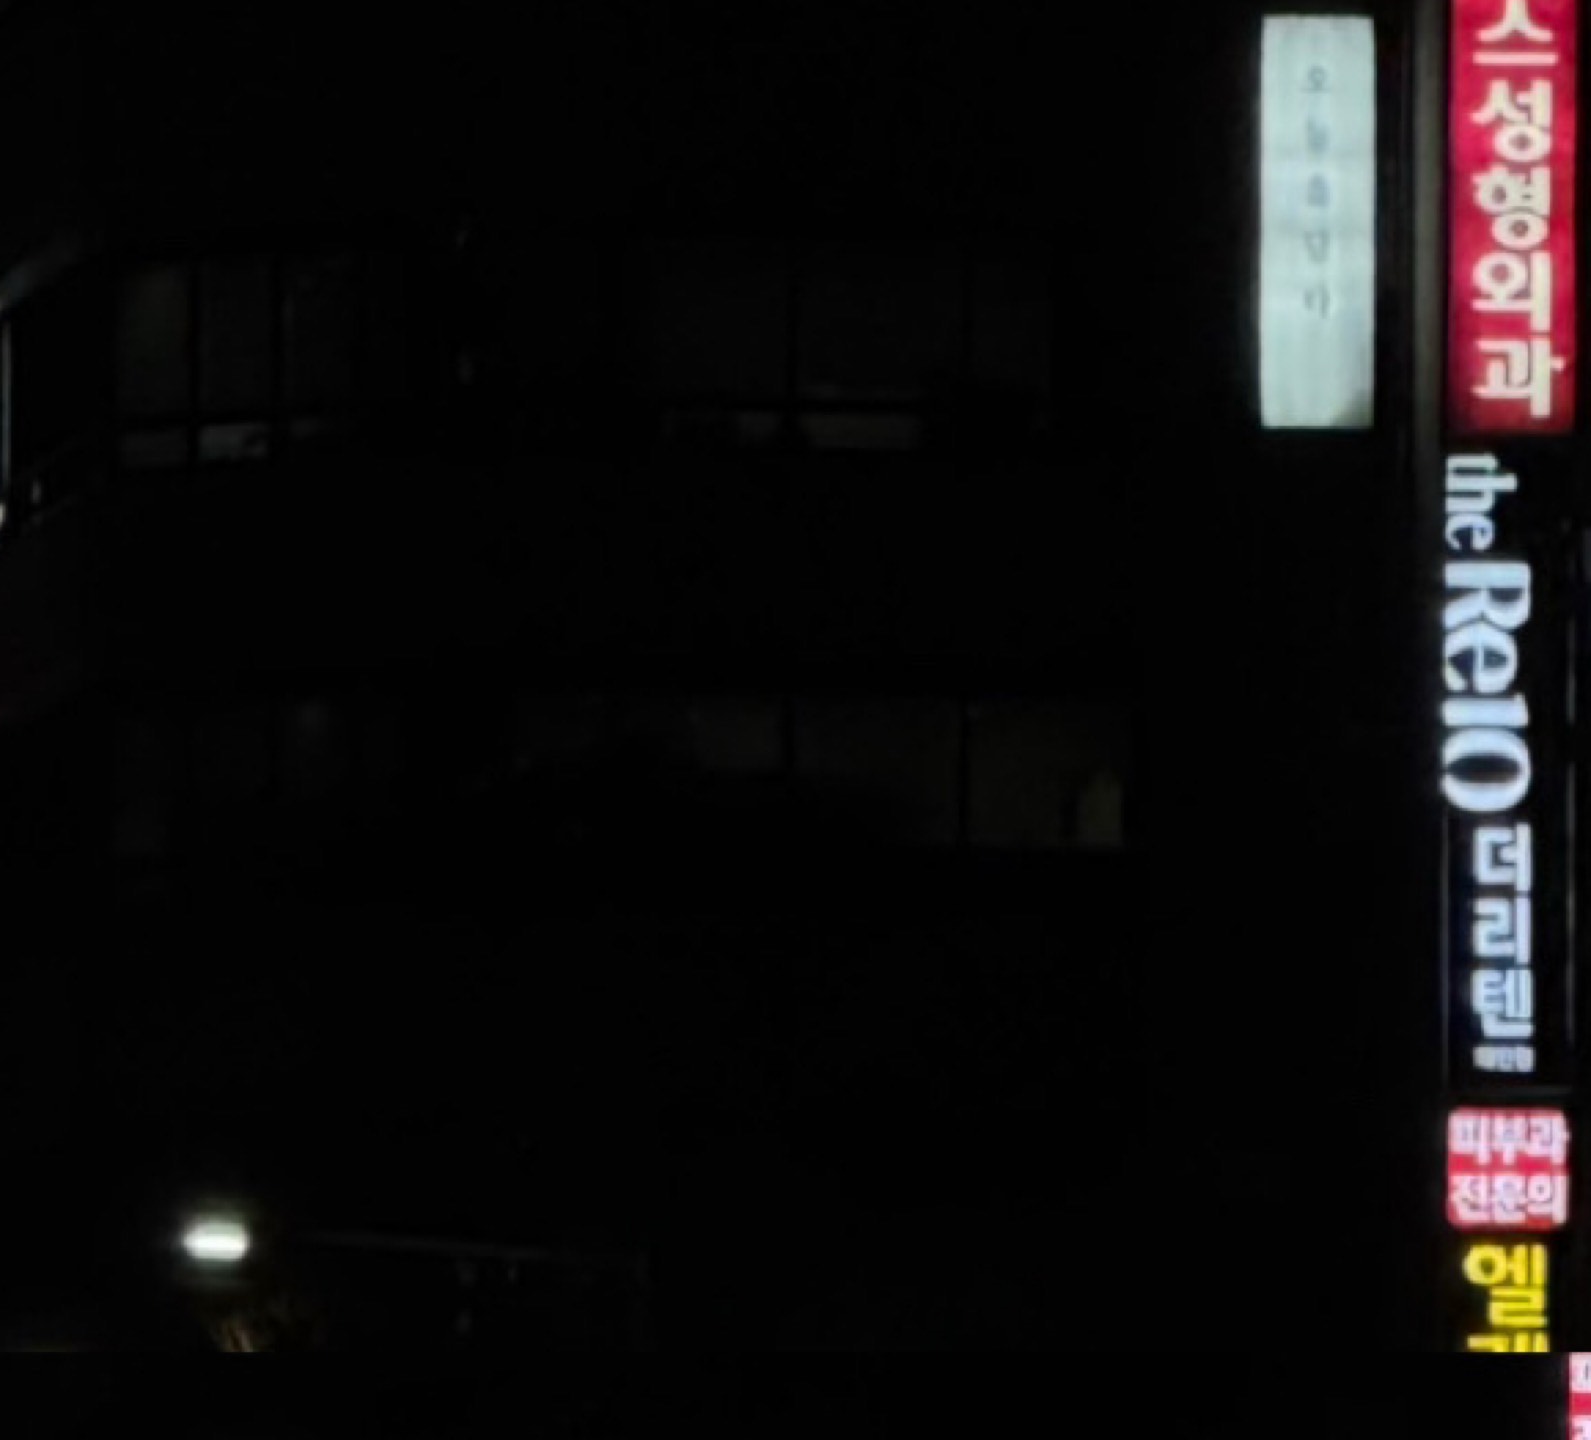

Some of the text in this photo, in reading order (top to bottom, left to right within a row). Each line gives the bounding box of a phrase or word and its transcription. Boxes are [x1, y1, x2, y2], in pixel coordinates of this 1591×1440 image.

[1444, 453, 1518, 551] the
[1469, 822, 1535, 1041] 더리텐
[1449, 1113, 1571, 1166] 피부과
[1449, 1171, 1569, 1225] 전문의
